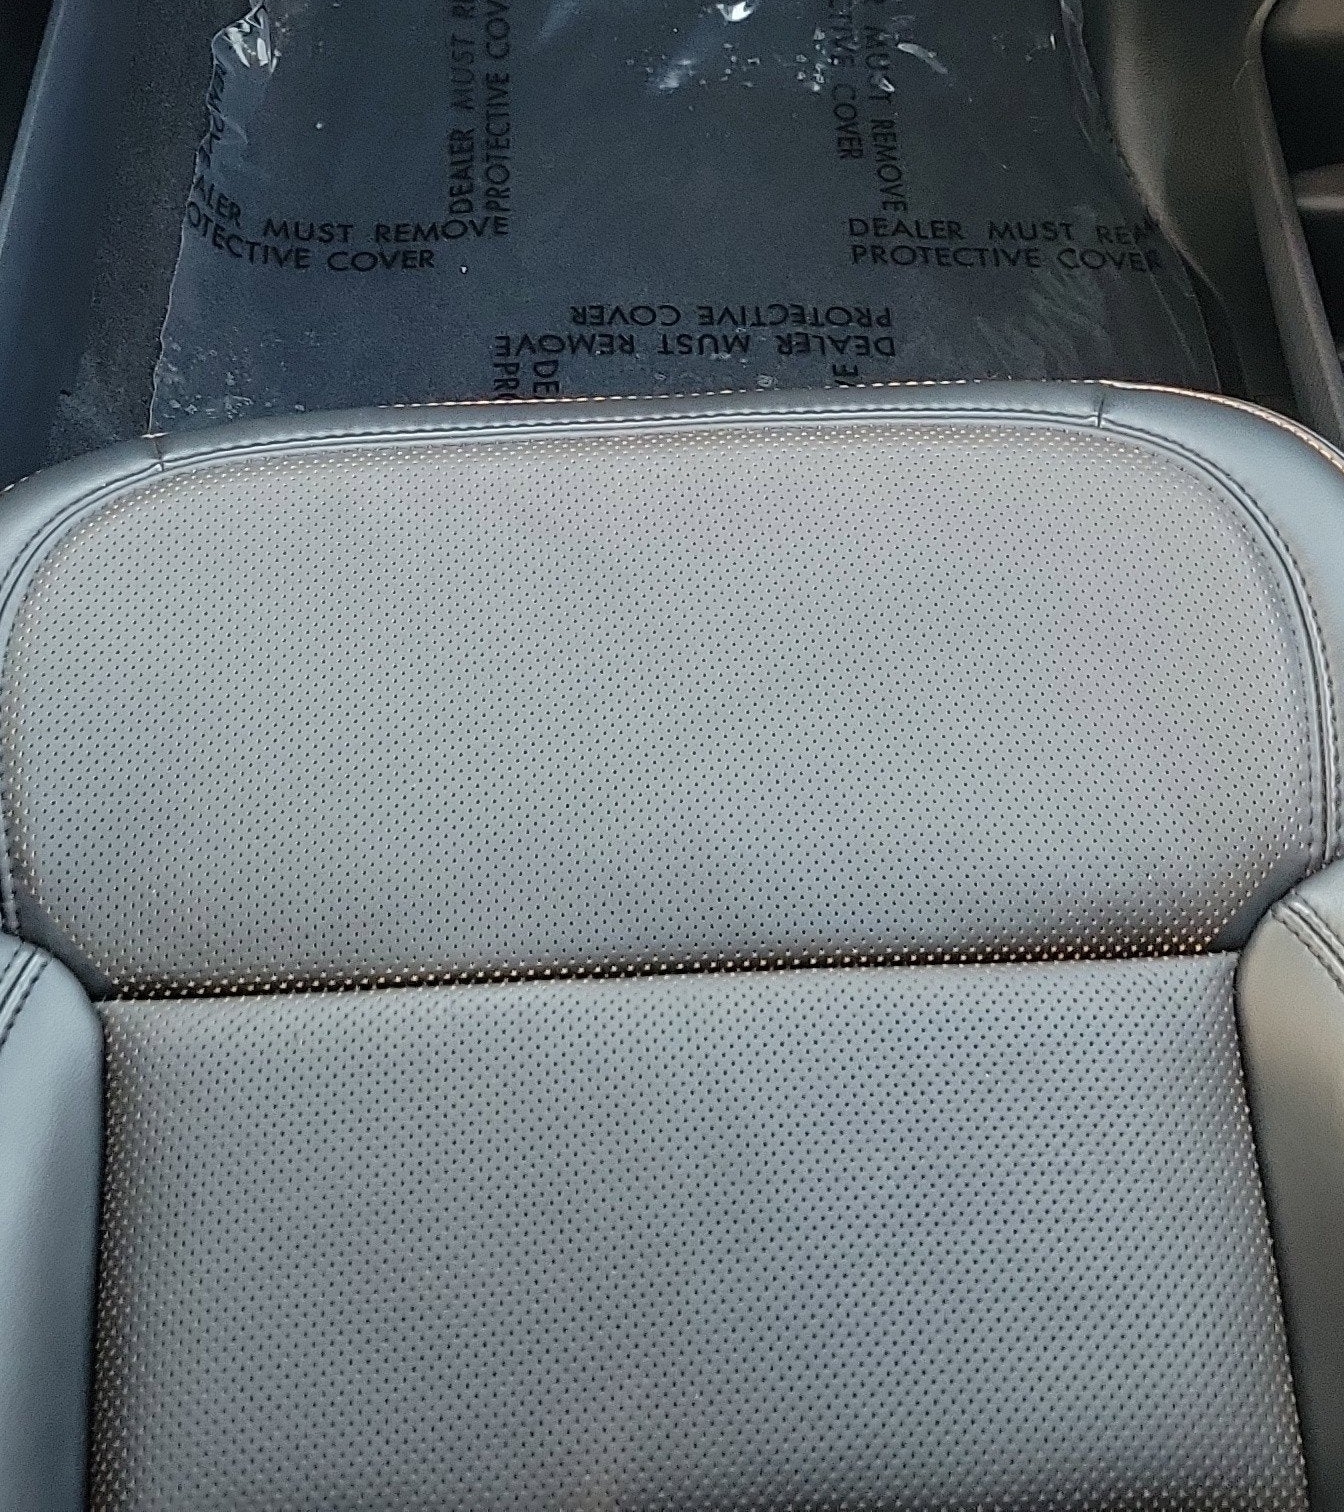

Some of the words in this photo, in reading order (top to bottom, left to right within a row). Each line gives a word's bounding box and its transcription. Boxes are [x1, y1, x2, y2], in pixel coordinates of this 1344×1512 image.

[485, 72, 512, 216] PROTECTIVE
[870, 118, 910, 214] REMOVE
[262, 218, 355, 245] MUST
[374, 215, 510, 244] REMOVE
[848, 218, 964, 241] DEALER
[988, 220, 1075, 243] MUST
[327, 248, 436, 274] COVER
[850, 244, 1042, 270] PROTECTIVE
[1055, 246, 1167, 274] COVER
[569, 304, 682, 327] COVER
[698, 302, 892, 328] PROTECTIVE
[495, 333, 635, 357] REMOVE
[657, 332, 751, 356] MUST
[776, 332, 896, 358] DEALER
